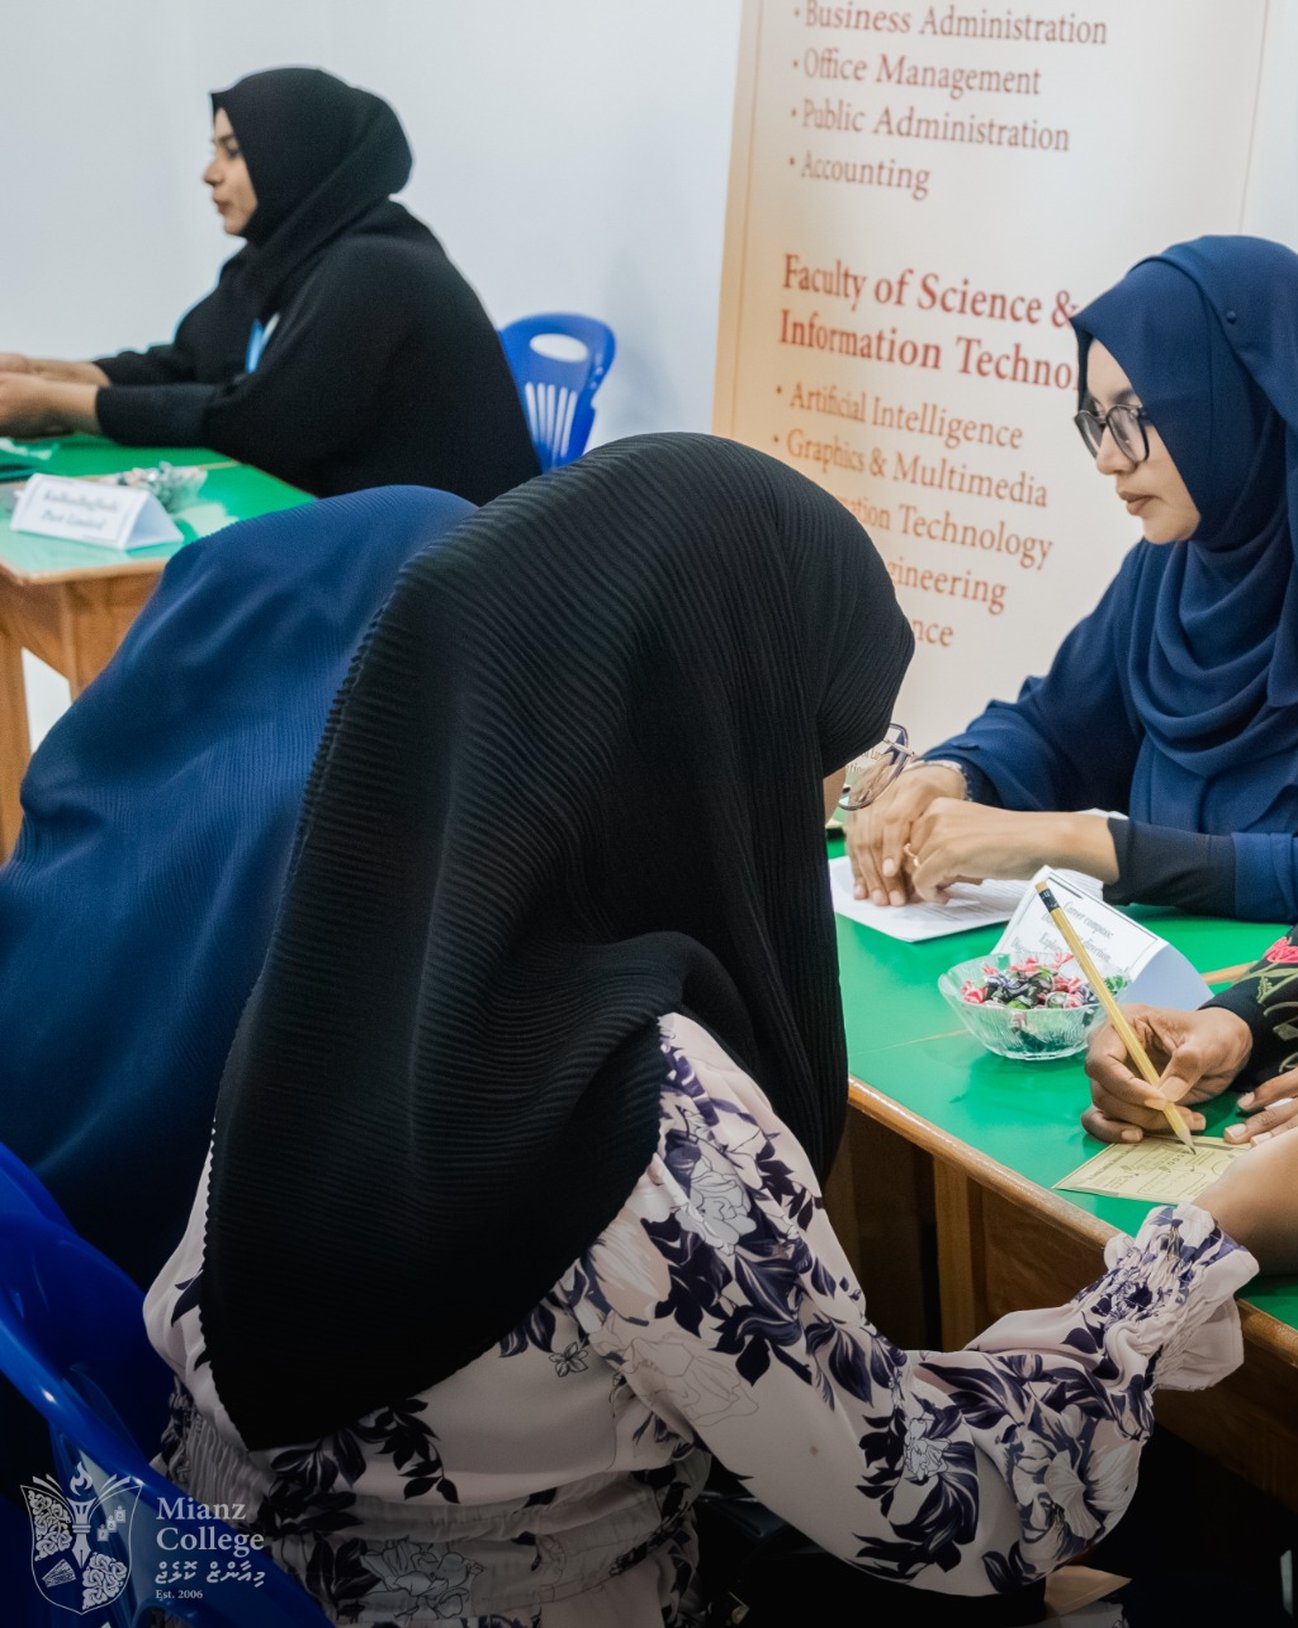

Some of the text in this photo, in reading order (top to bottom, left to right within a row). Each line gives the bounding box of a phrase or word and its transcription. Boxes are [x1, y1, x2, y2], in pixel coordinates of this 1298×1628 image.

[805, 0, 1107, 44] Business Administration
[804, 47, 1041, 100] Office Management
[803, 100, 1070, 151] Public Administration
[801, 153, 930, 200] Accounting
[784, 253, 1079, 328] Faculty of Science &
[779, 311, 1078, 390] Information Techno
[790, 382, 1023, 449] Artificial Intelligence
[787, 429, 1048, 508] Graphics & Multimedia
[899, 504, 1053, 571] Technology
